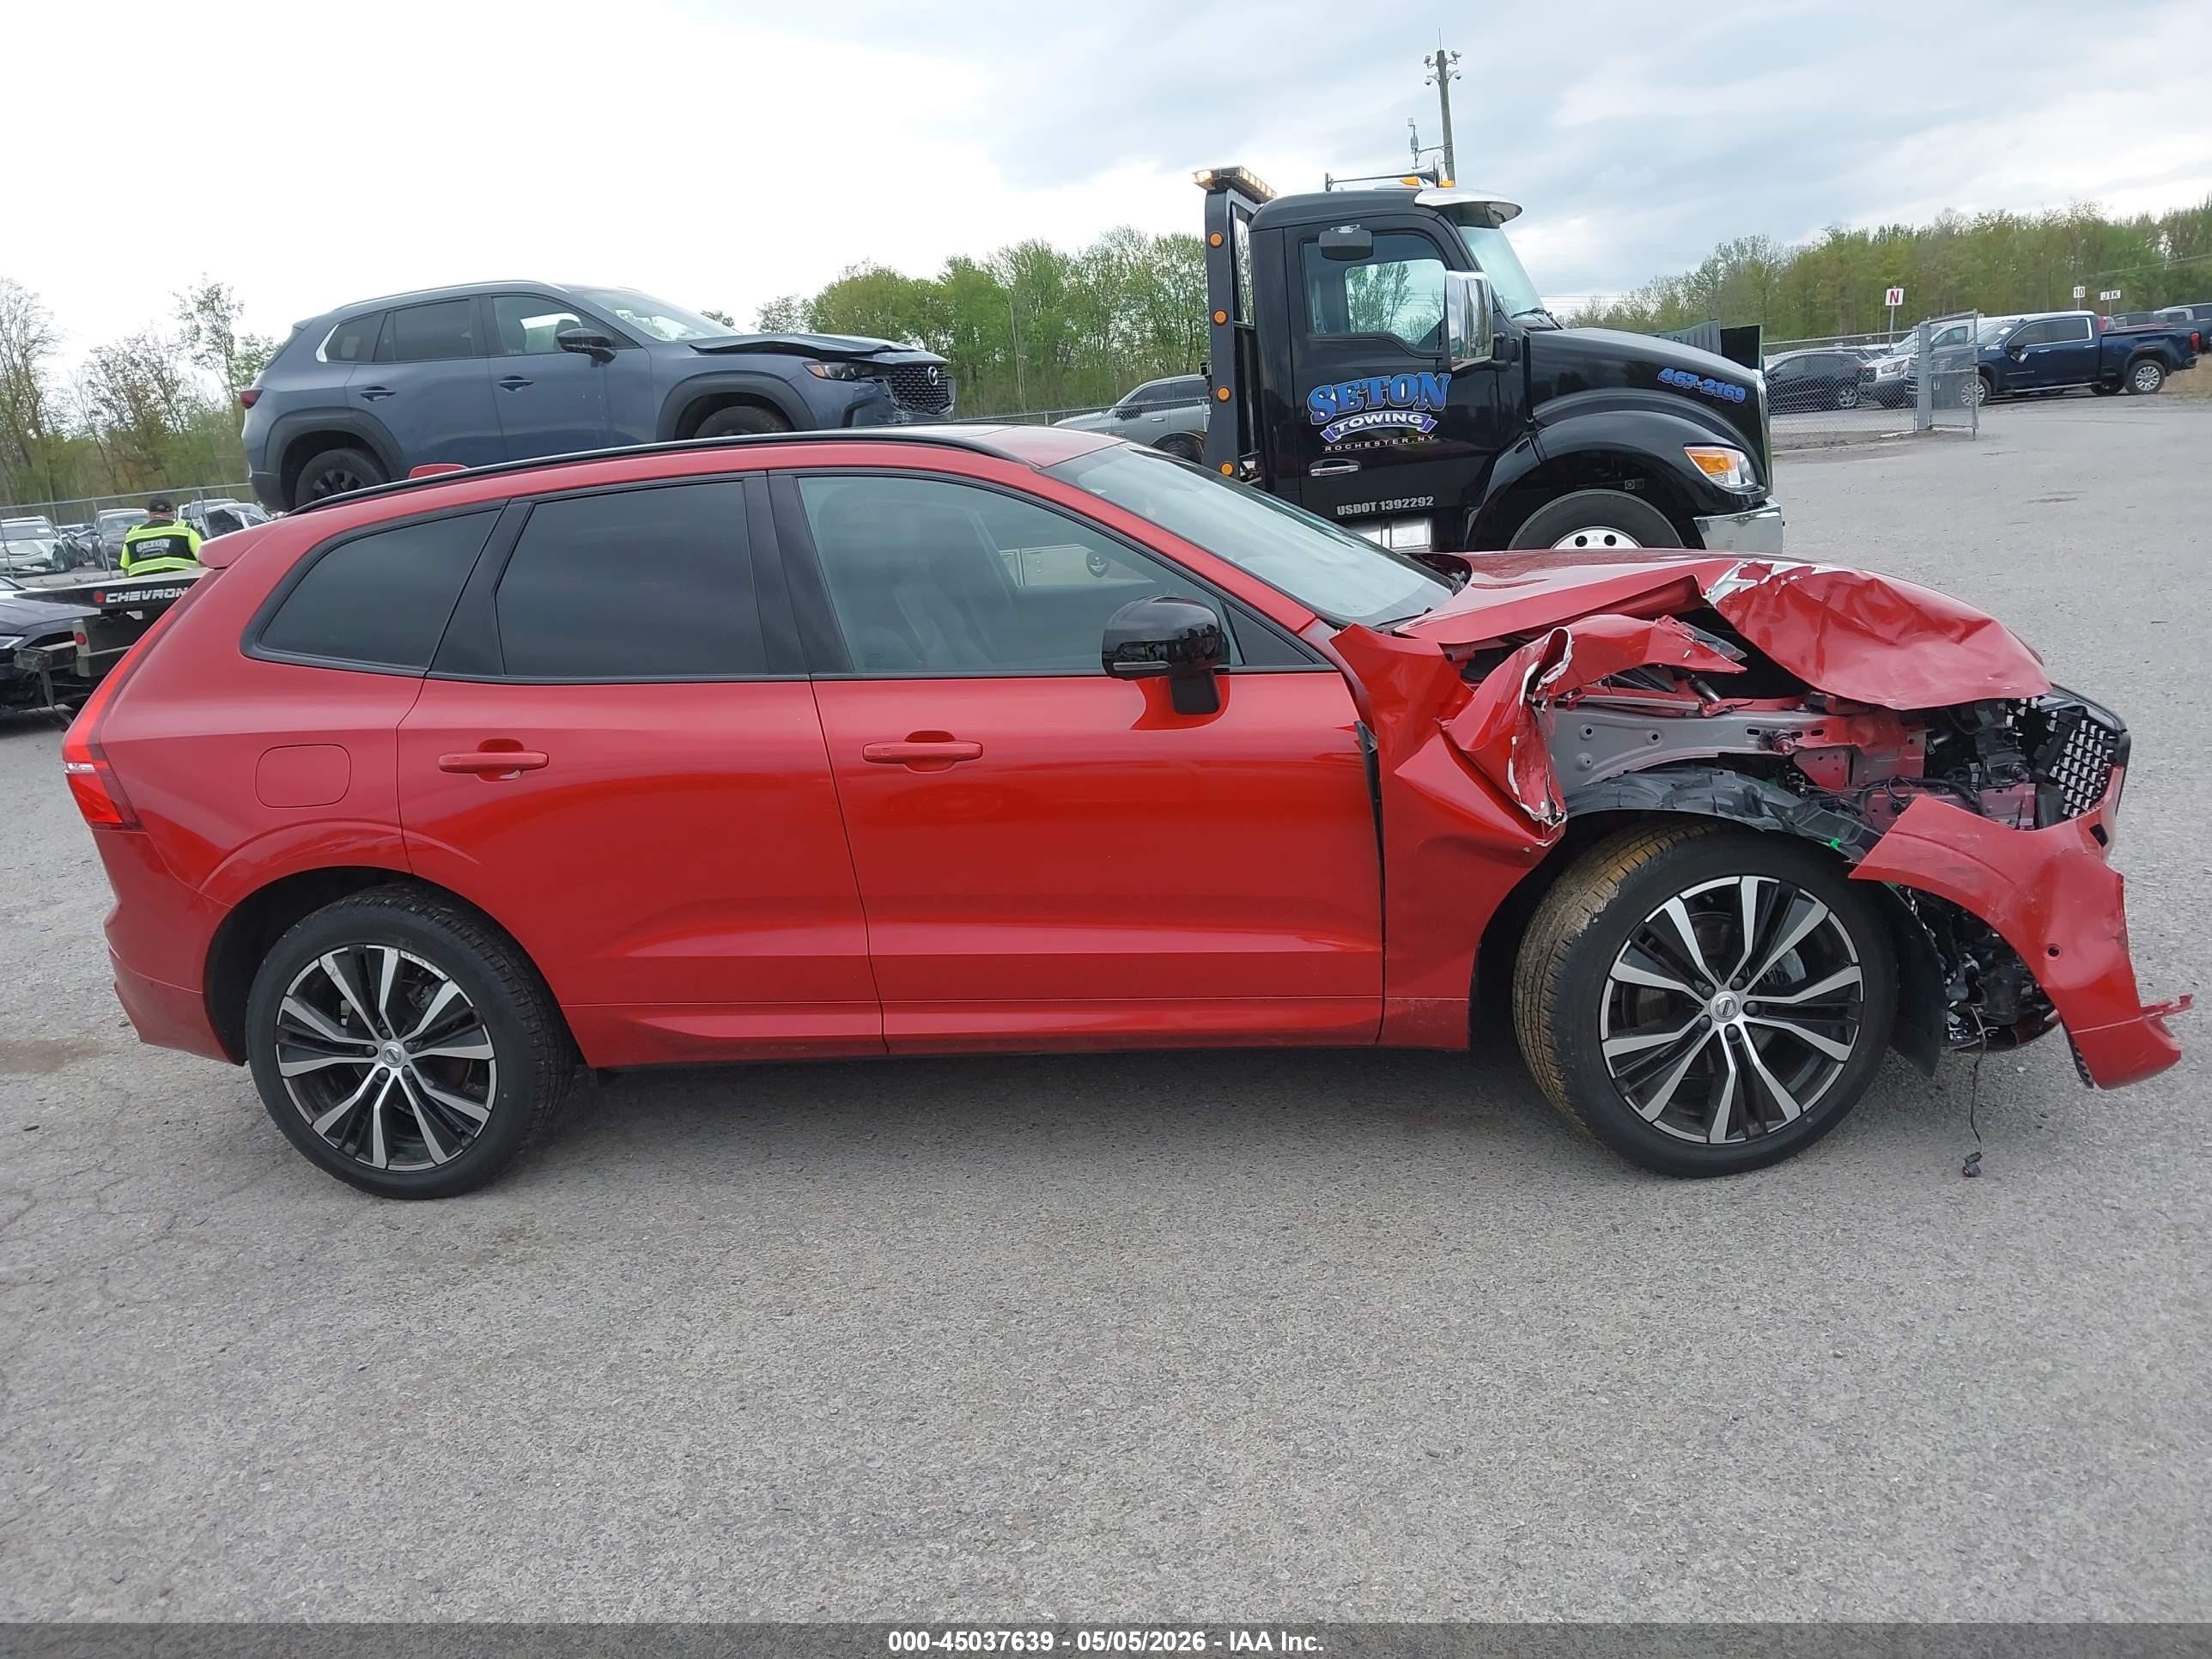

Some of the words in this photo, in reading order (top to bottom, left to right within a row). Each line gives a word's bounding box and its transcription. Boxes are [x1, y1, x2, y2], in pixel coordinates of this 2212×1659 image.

[1890, 290, 1899, 304] N
[2075, 288, 2084, 296] 10
[1657, 368, 1746, 404] 467-2169
[1307, 372, 1452, 425] SETON
[1334, 413, 1423, 433] TOWING
[1337, 501, 1377, 516] USDOT
[1379, 495, 1434, 511] 1392292
[106, 586, 189, 604] CHEVRON
